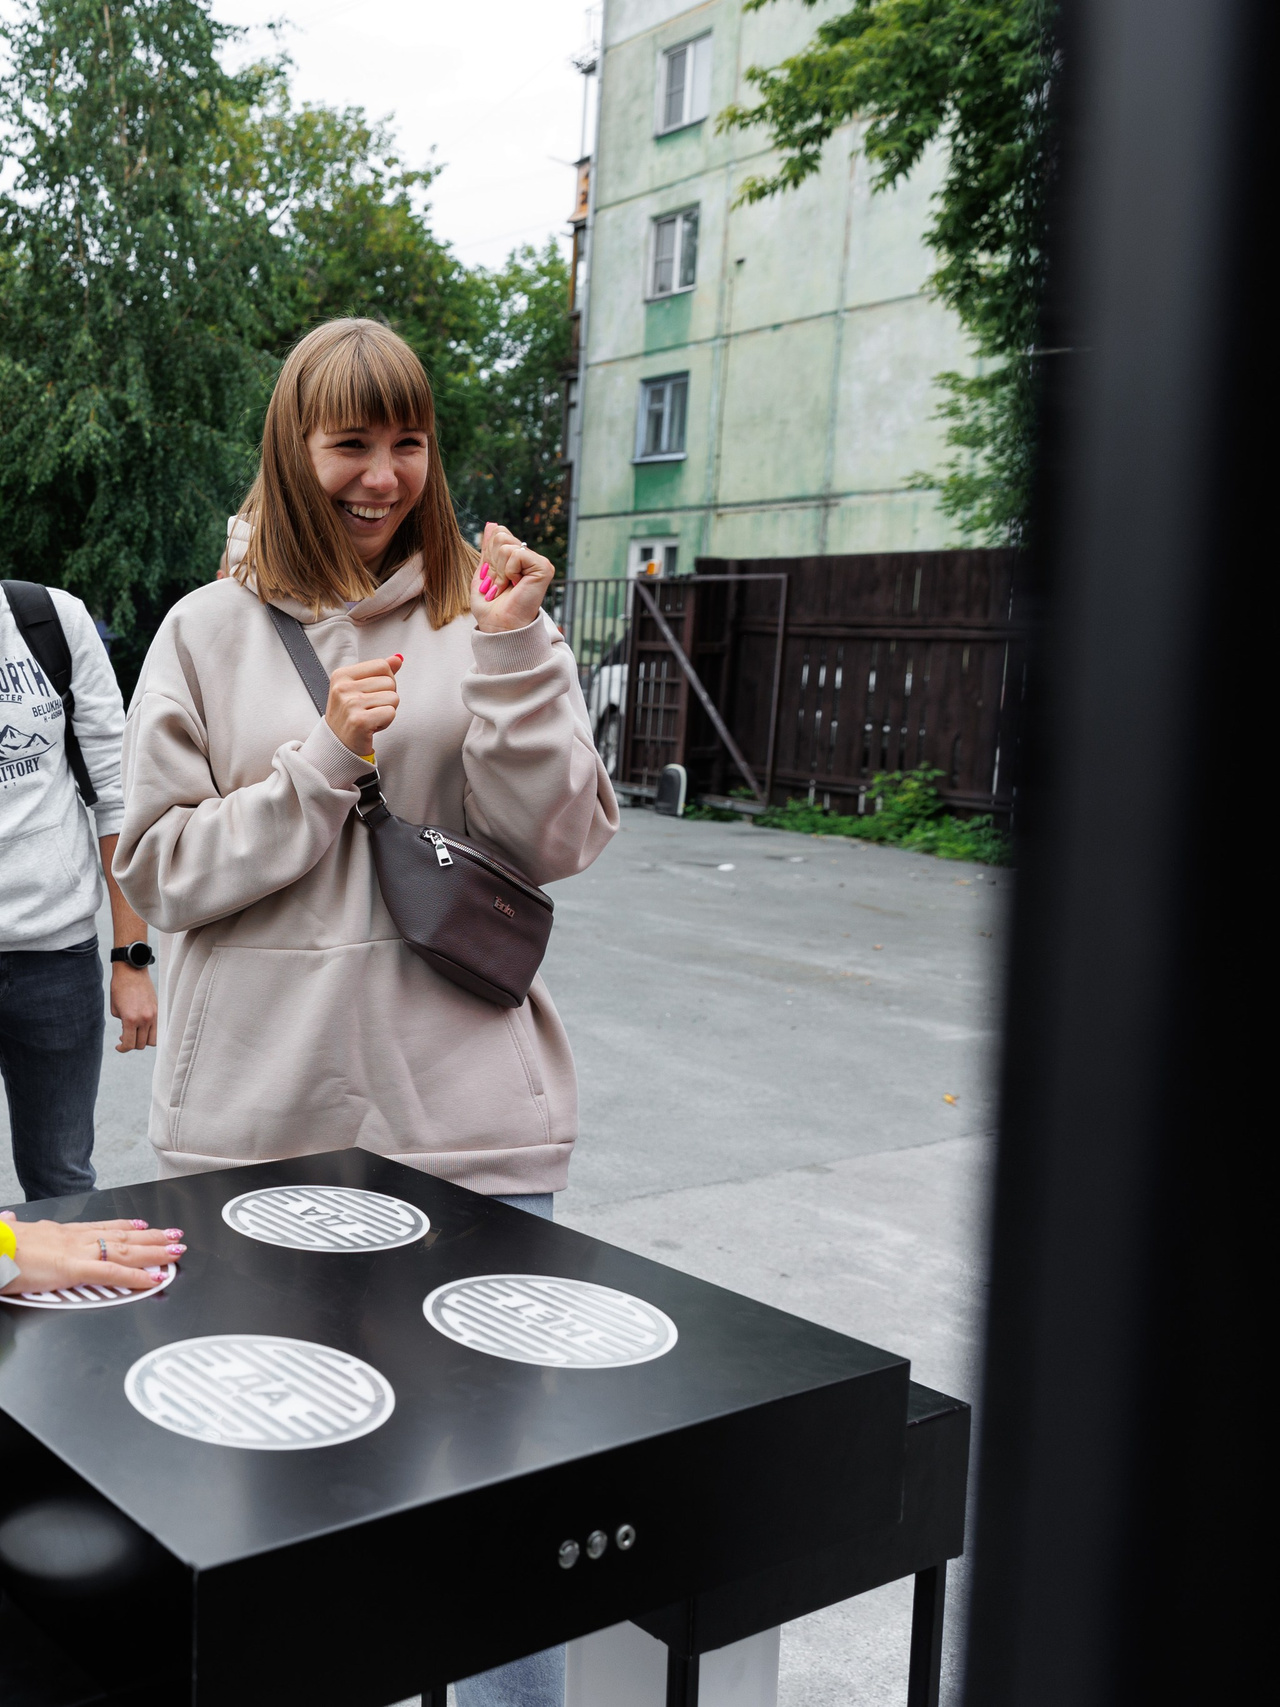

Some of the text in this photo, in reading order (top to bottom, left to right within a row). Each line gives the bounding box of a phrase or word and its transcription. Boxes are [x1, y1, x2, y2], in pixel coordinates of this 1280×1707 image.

[300, 1206, 358, 1227] ДА
[501, 1303, 594, 1338] НЕТ
[219, 1372, 293, 1407] ДА
